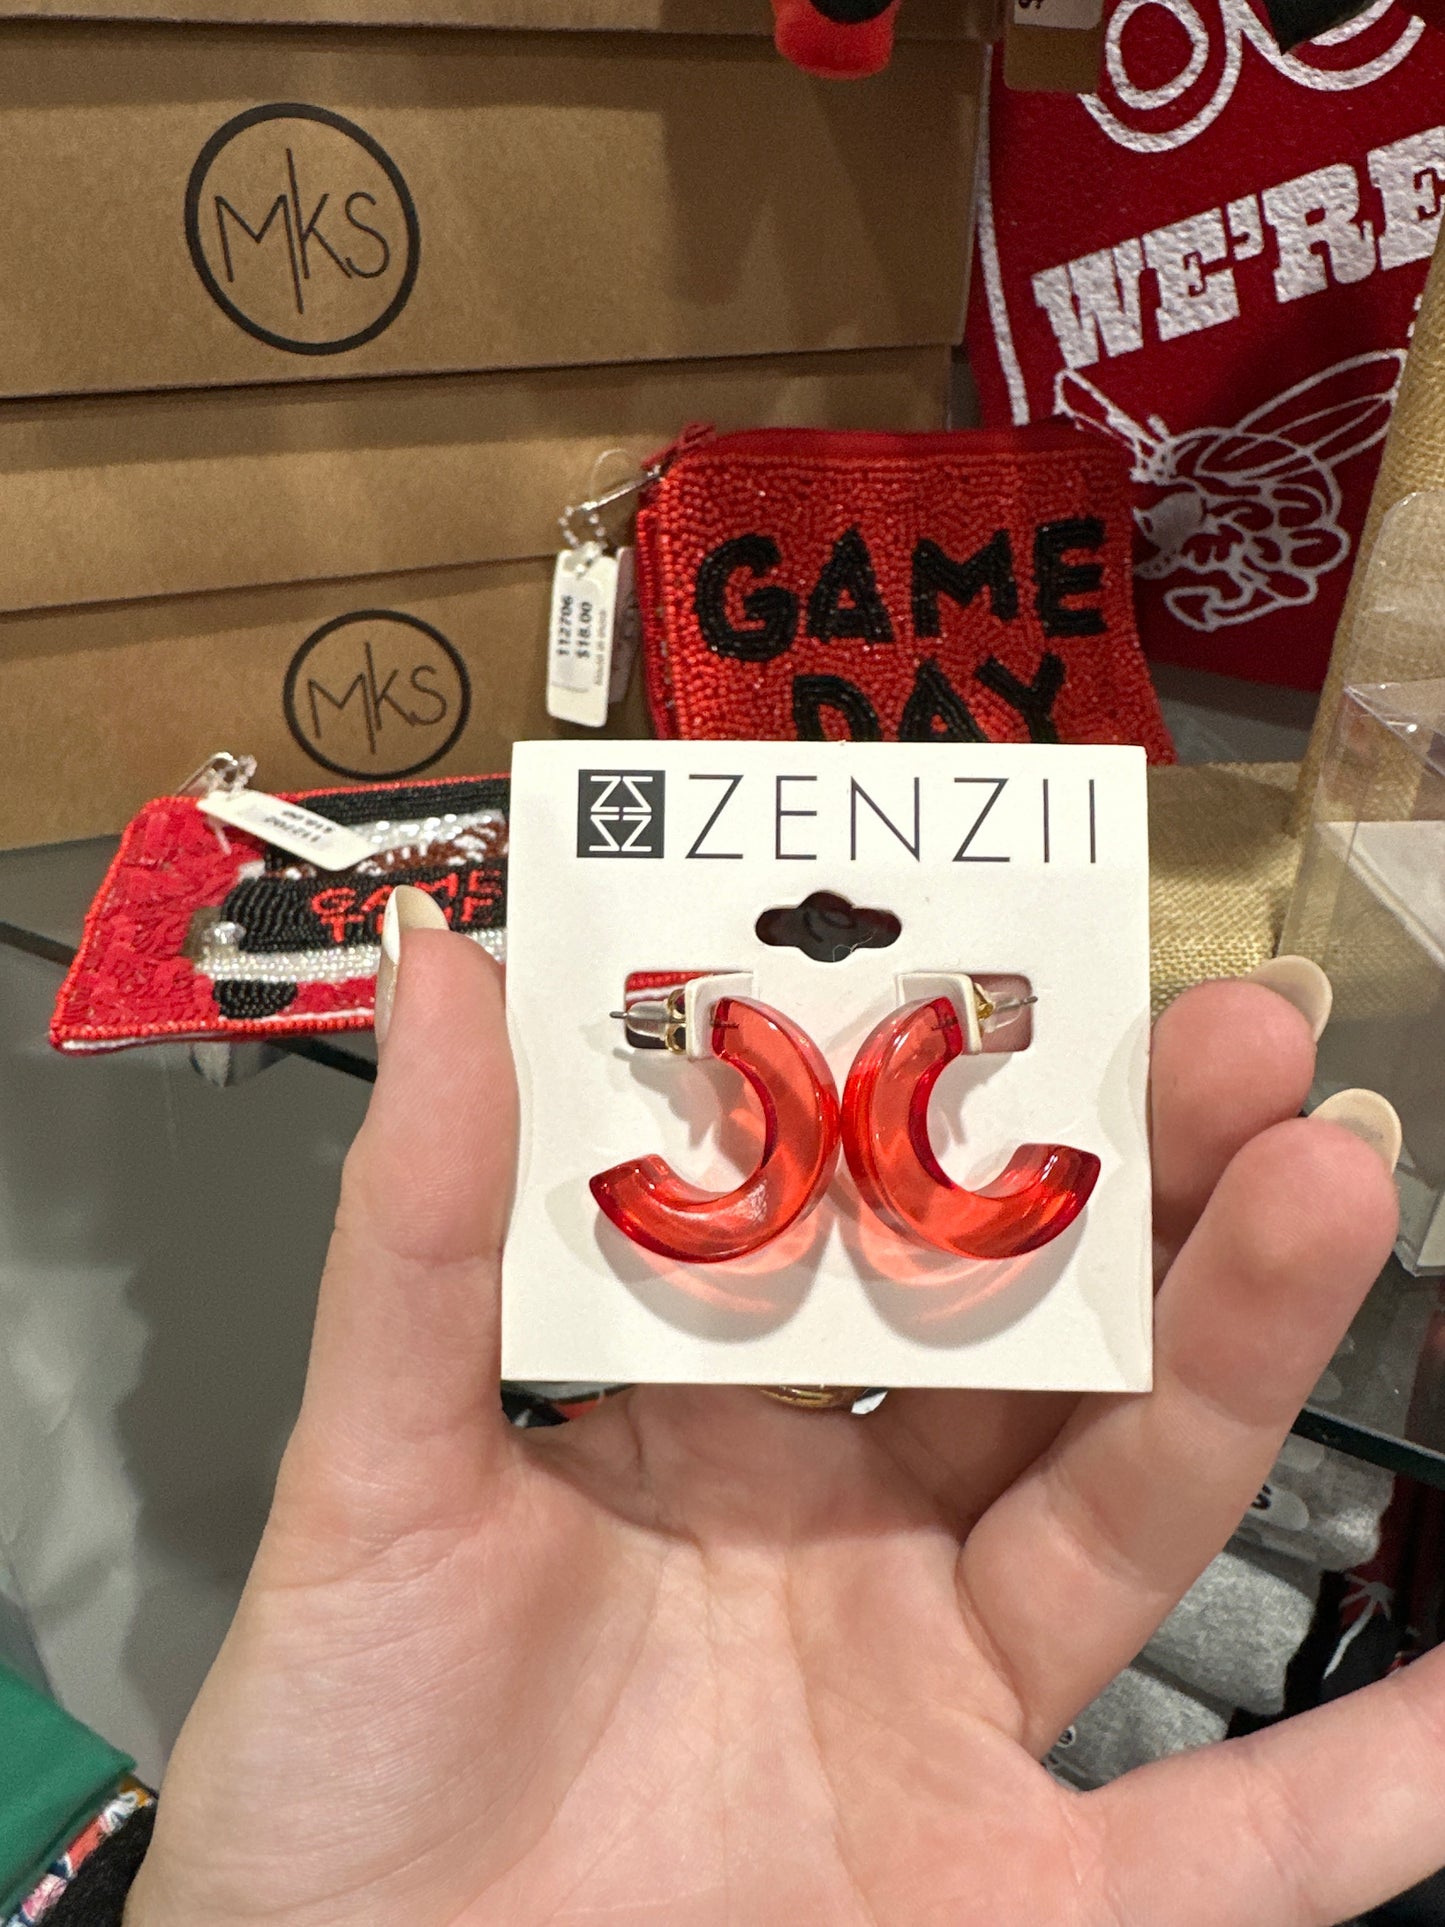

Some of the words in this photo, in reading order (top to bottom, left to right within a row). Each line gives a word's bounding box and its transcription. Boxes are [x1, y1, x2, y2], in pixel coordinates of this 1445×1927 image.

[1031, 125, 1445, 370] WE'RE
[694, 515, 1107, 662] GAME
[791, 649, 1067, 743] DAY
[685, 773, 1097, 863] ZENZII
